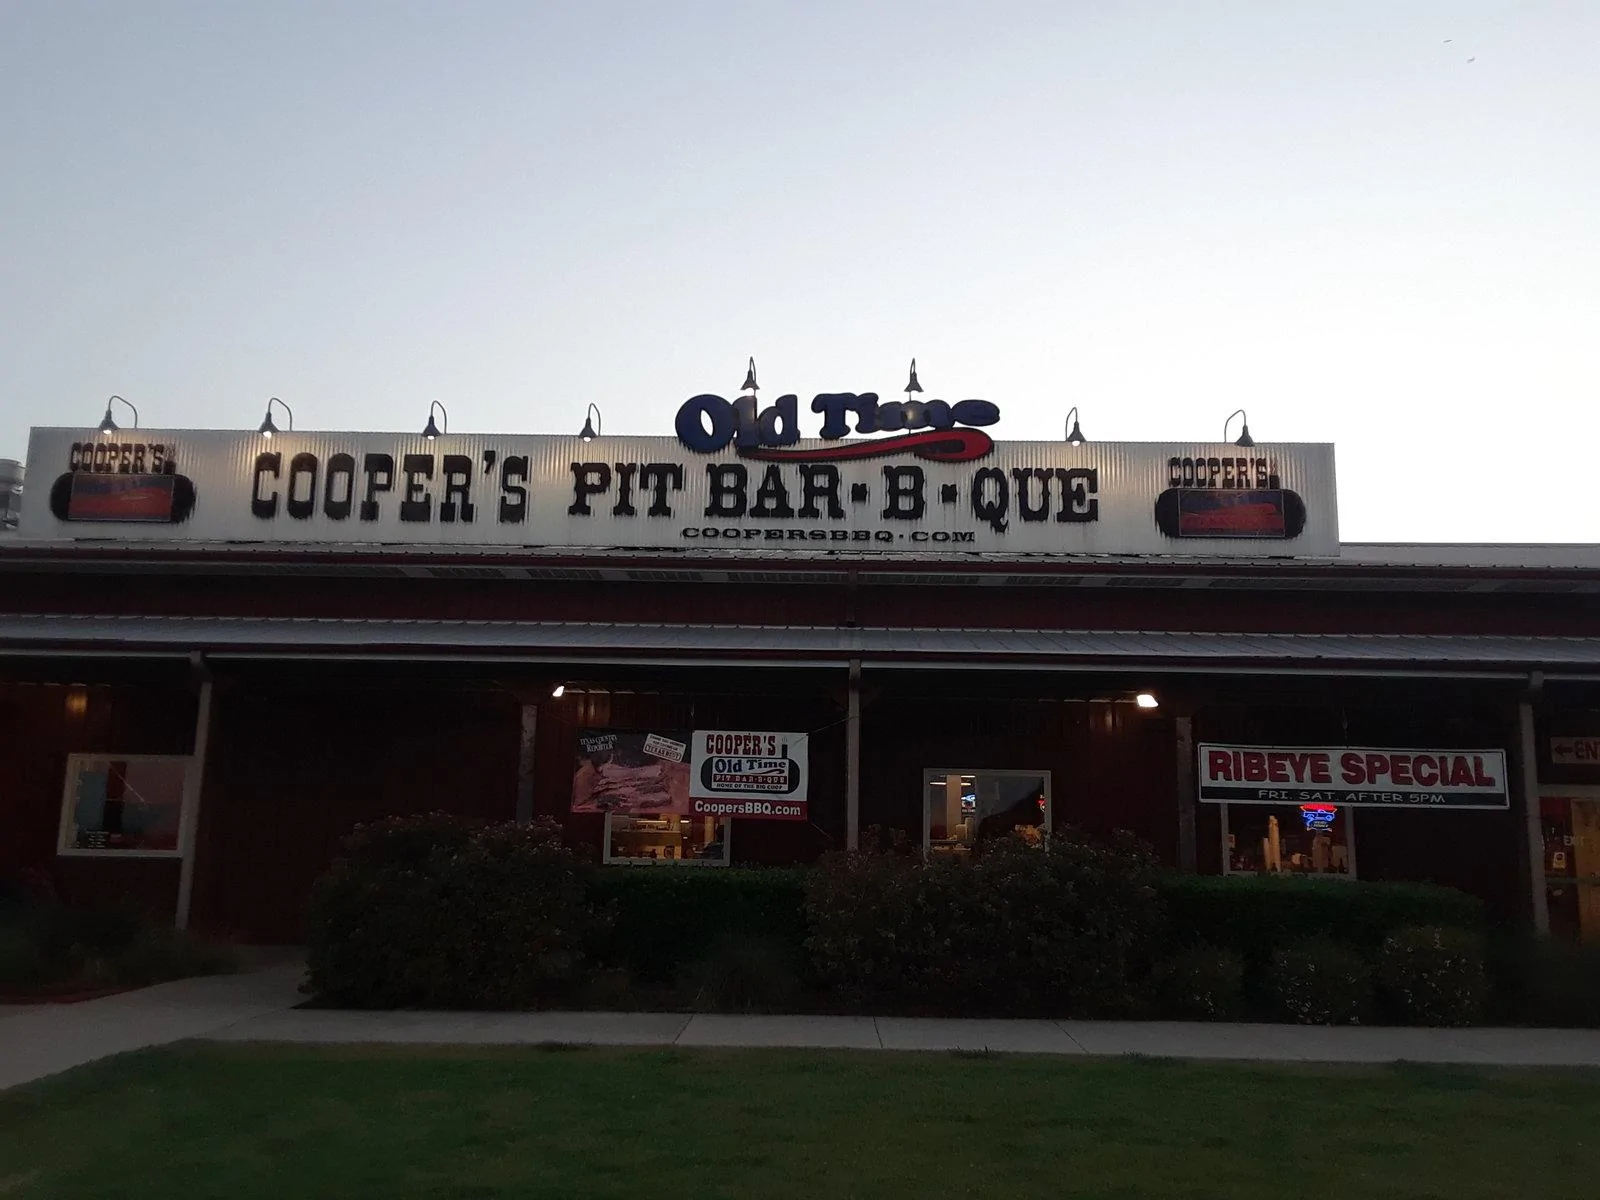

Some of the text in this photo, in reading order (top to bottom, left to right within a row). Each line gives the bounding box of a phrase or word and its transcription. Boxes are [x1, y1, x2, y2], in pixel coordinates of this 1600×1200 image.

[675, 392, 1000, 453] Old Time
[70, 442, 165, 473] COOPER'S
[1169, 457, 1267, 489] COOPER'S
[252, 450, 530, 523] COOPER'S
[568, 462, 683, 517] PIT
[706, 733, 776, 756] COOPER'S
[715, 758, 787, 773] Old Time
[1209, 750, 1496, 787] RIBEYE SPECIAL
[694, 800, 801, 816] CoopersBBQ.com
[1258, 790, 1292, 801] FRI.
[1345, 792, 1403, 803] AFTER
[1410, 793, 1446, 803] 5PM
